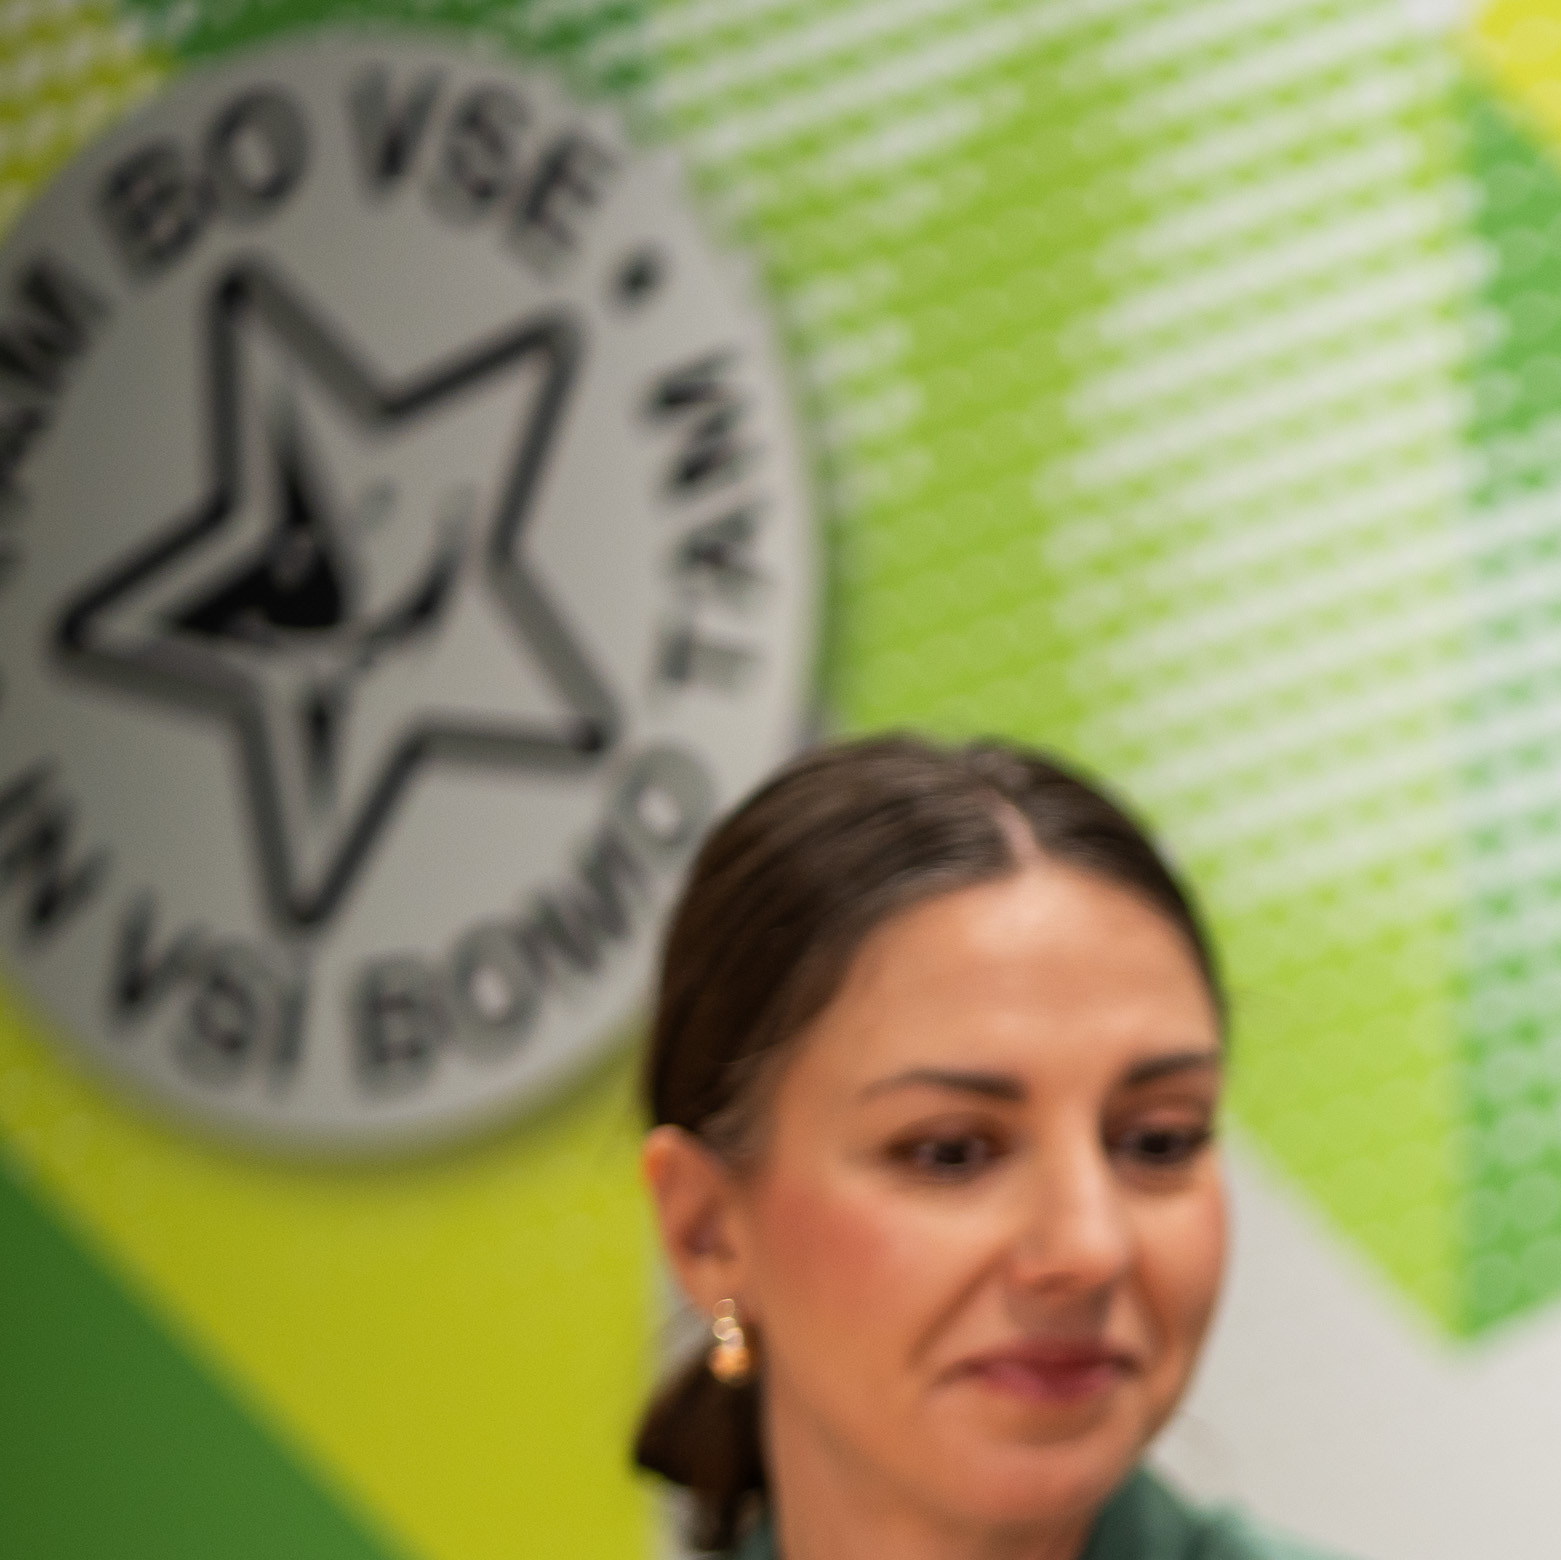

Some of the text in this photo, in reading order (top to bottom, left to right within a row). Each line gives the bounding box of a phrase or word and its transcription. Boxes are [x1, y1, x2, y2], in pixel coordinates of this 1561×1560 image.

[95, 82, 312, 288] BO
[345, 64, 615, 280] VSE
[348, 742, 715, 1095] BOMO
